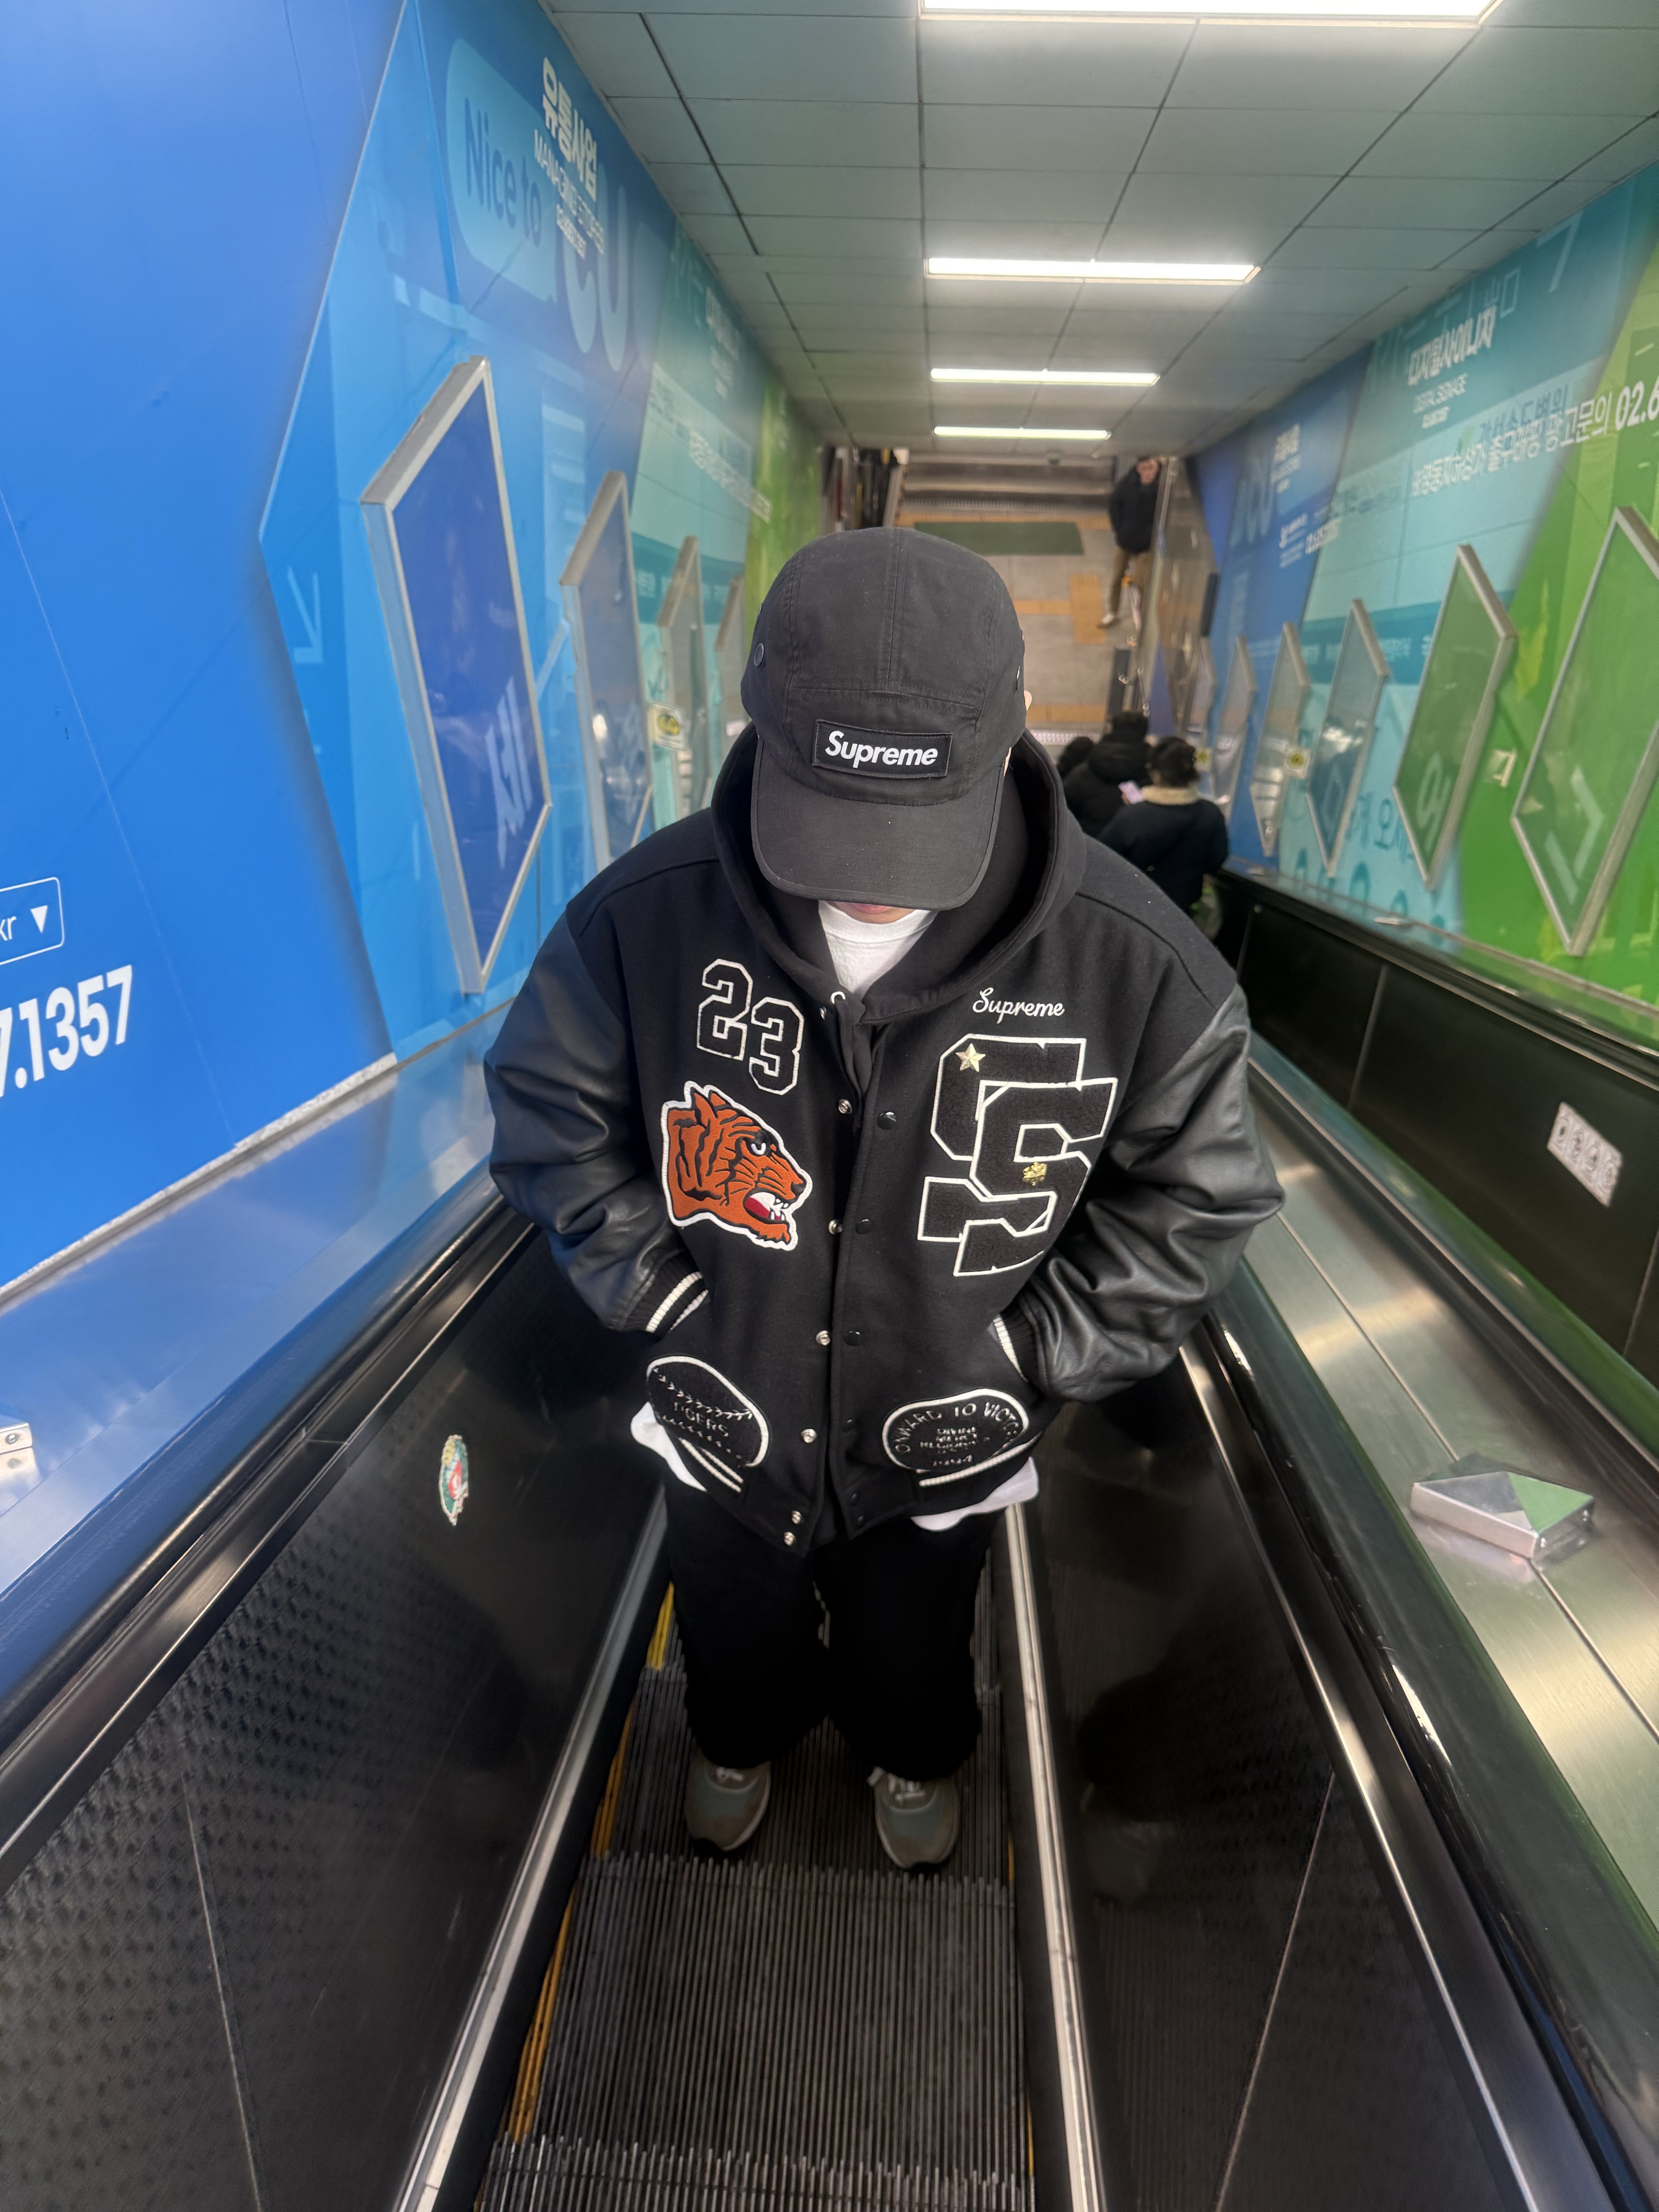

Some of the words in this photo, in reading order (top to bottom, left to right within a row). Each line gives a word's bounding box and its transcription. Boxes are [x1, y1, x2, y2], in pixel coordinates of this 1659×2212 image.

[465, 98, 517, 228] Nice
[522, 157, 541, 248] to
[543, 57, 597, 203] 유통사업
[825, 731, 938, 768] Supreme
[697, 958, 804, 1096] 23
[972, 988, 1065, 1024] Supreme
